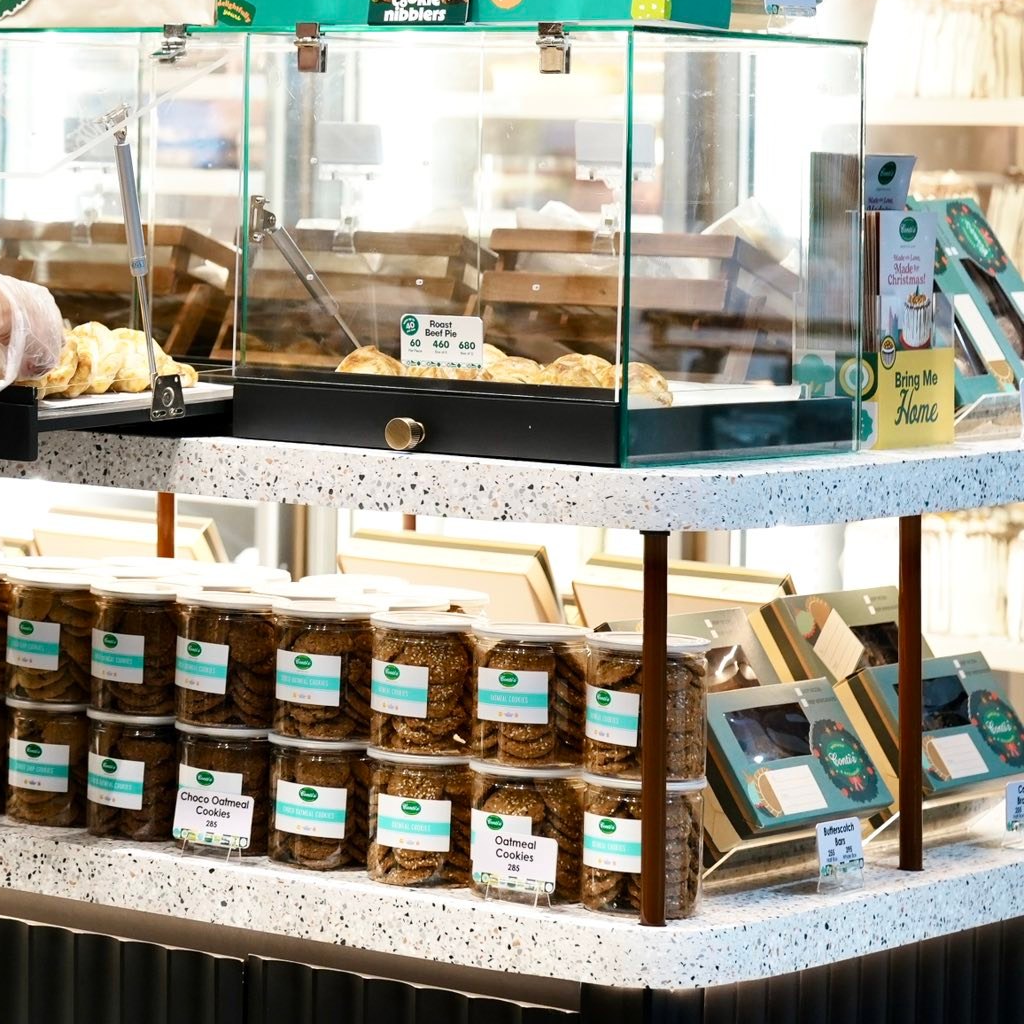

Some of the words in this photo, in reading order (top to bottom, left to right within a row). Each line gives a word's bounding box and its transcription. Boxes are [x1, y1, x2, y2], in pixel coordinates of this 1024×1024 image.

[383, 7, 447, 22] nibblers
[893, 262, 912, 274] Made
[887, 273, 926, 286] Christmas!
[429, 319, 453, 329] Roast
[425, 328, 443, 337] Beef
[444, 329, 457, 338] Pie
[409, 338, 421, 348] 60
[432, 340, 450, 349] 460
[458, 341, 476, 350] 680
[895, 370, 920, 391] Bring
[923, 369, 939, 387] Me
[894, 387, 940, 426] Home
[180, 791, 210, 805] Choco
[211, 796, 250, 809] Oatmeal
[195, 806, 231, 819] Cookies
[206, 820, 218, 828] 285
[823, 822, 855, 836] Butterscotch
[494, 835, 537, 850] Oatmeal
[834, 837, 846, 846] Bars
[495, 848, 535, 863] Cookies
[507, 863, 521, 872] 285
